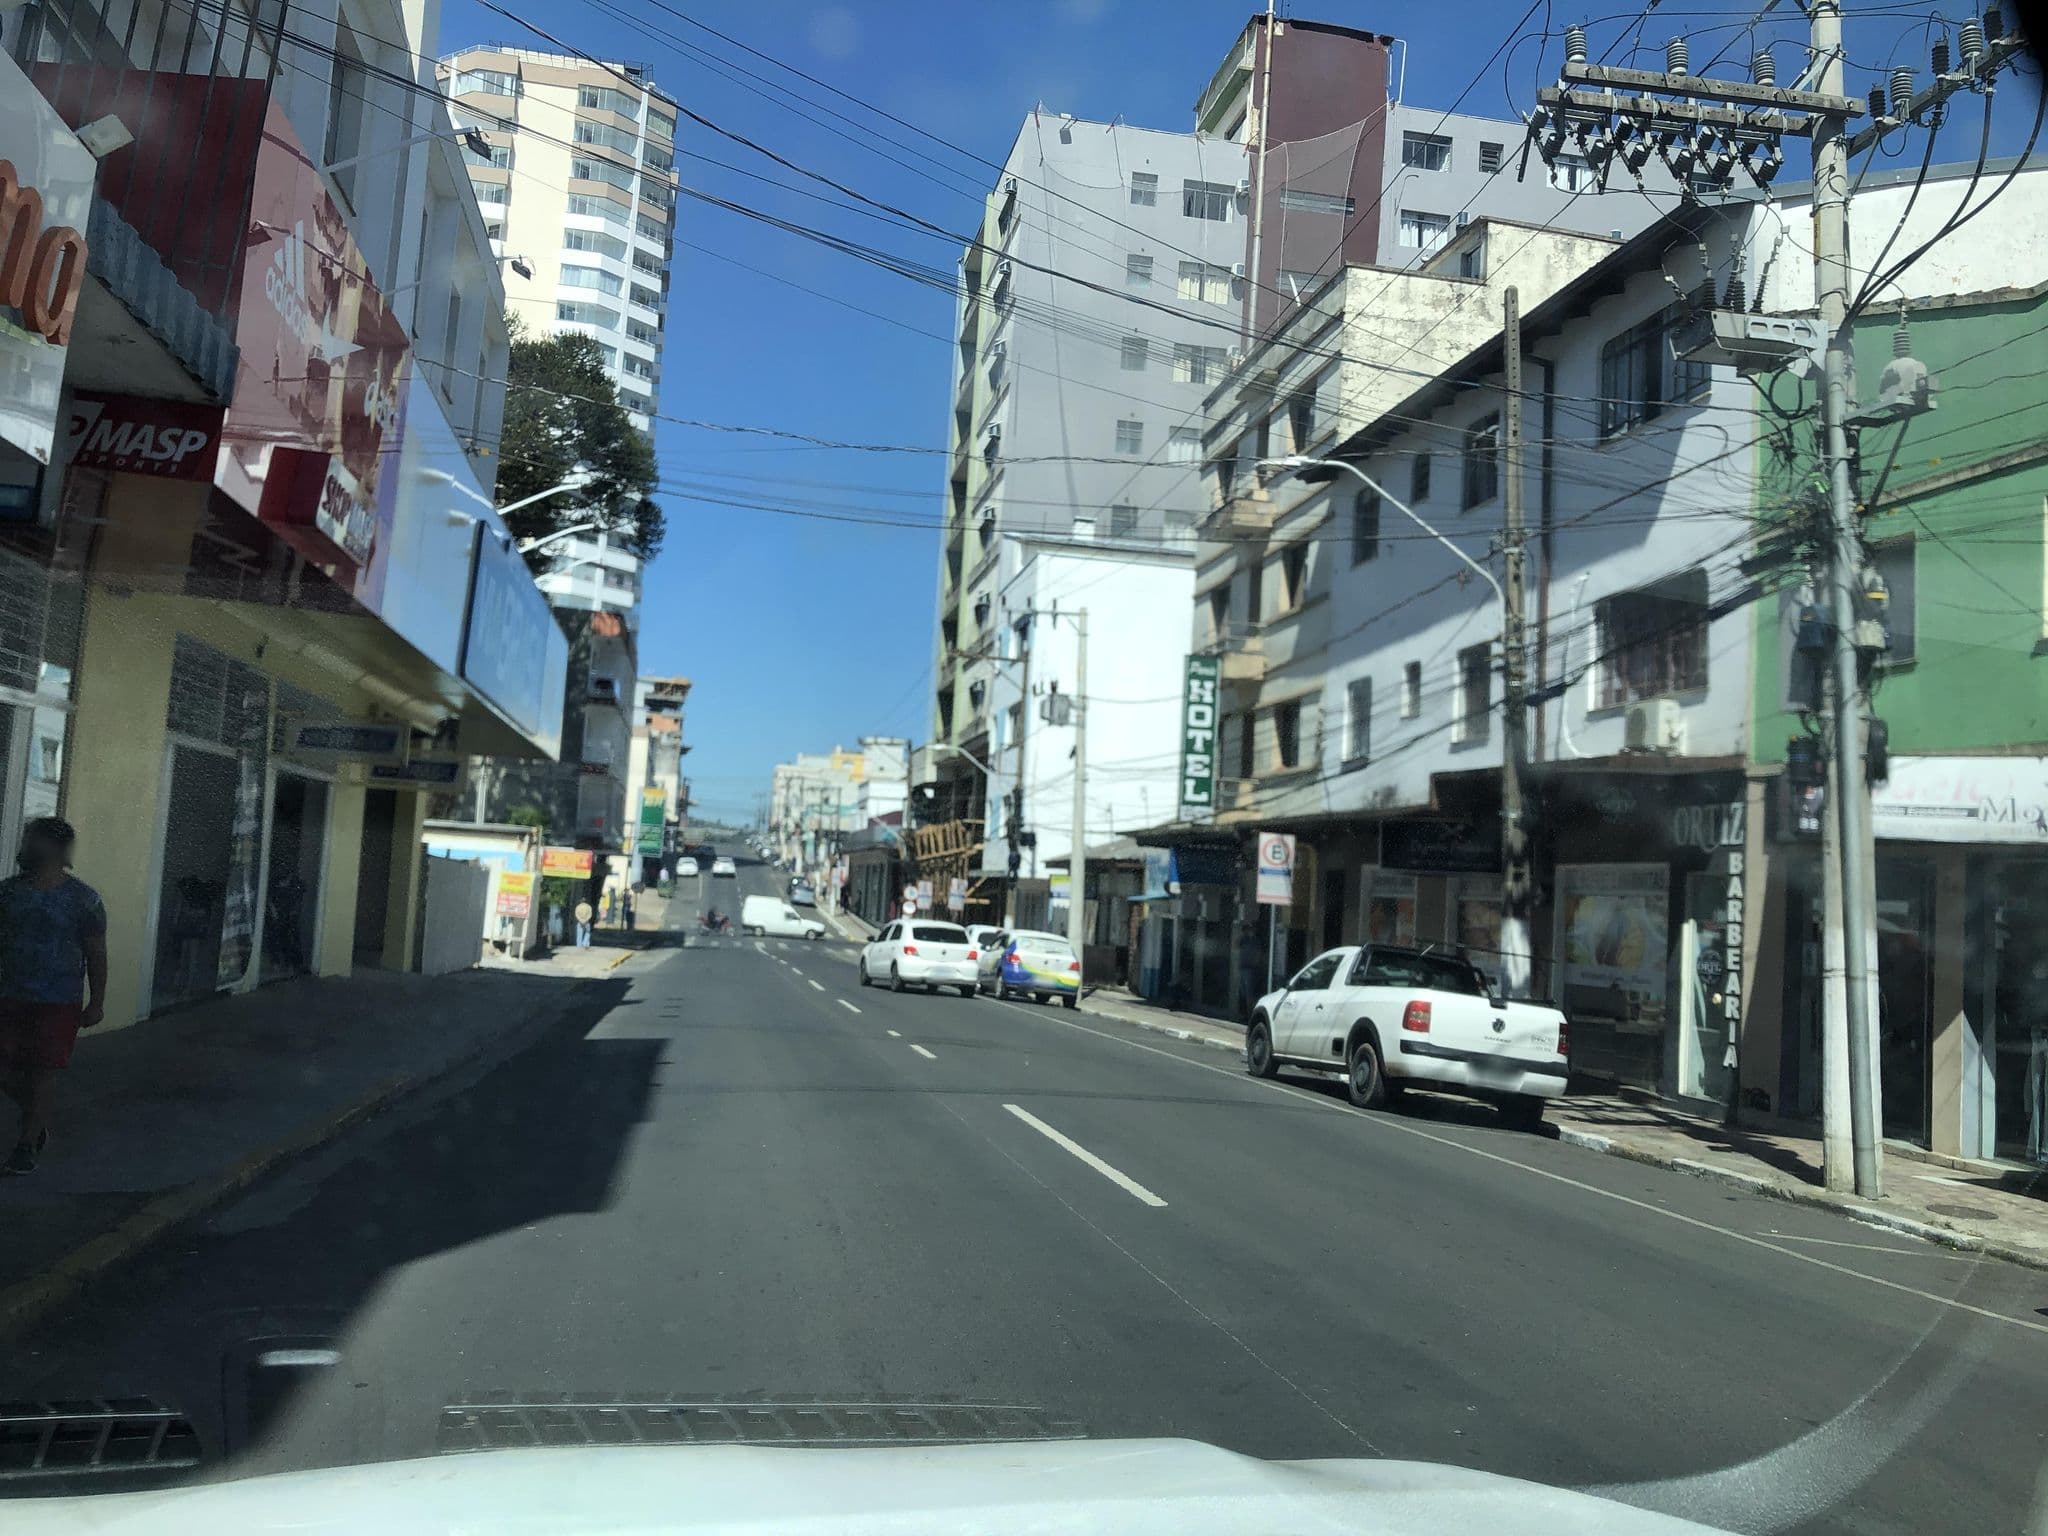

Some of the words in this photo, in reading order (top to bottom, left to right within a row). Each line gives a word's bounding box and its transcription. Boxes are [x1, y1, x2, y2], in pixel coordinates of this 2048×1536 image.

[86, 419, 208, 462] MASP
[1184, 679, 1215, 802] HOTEL
[1722, 852, 1744, 1069] BARBEARIA
